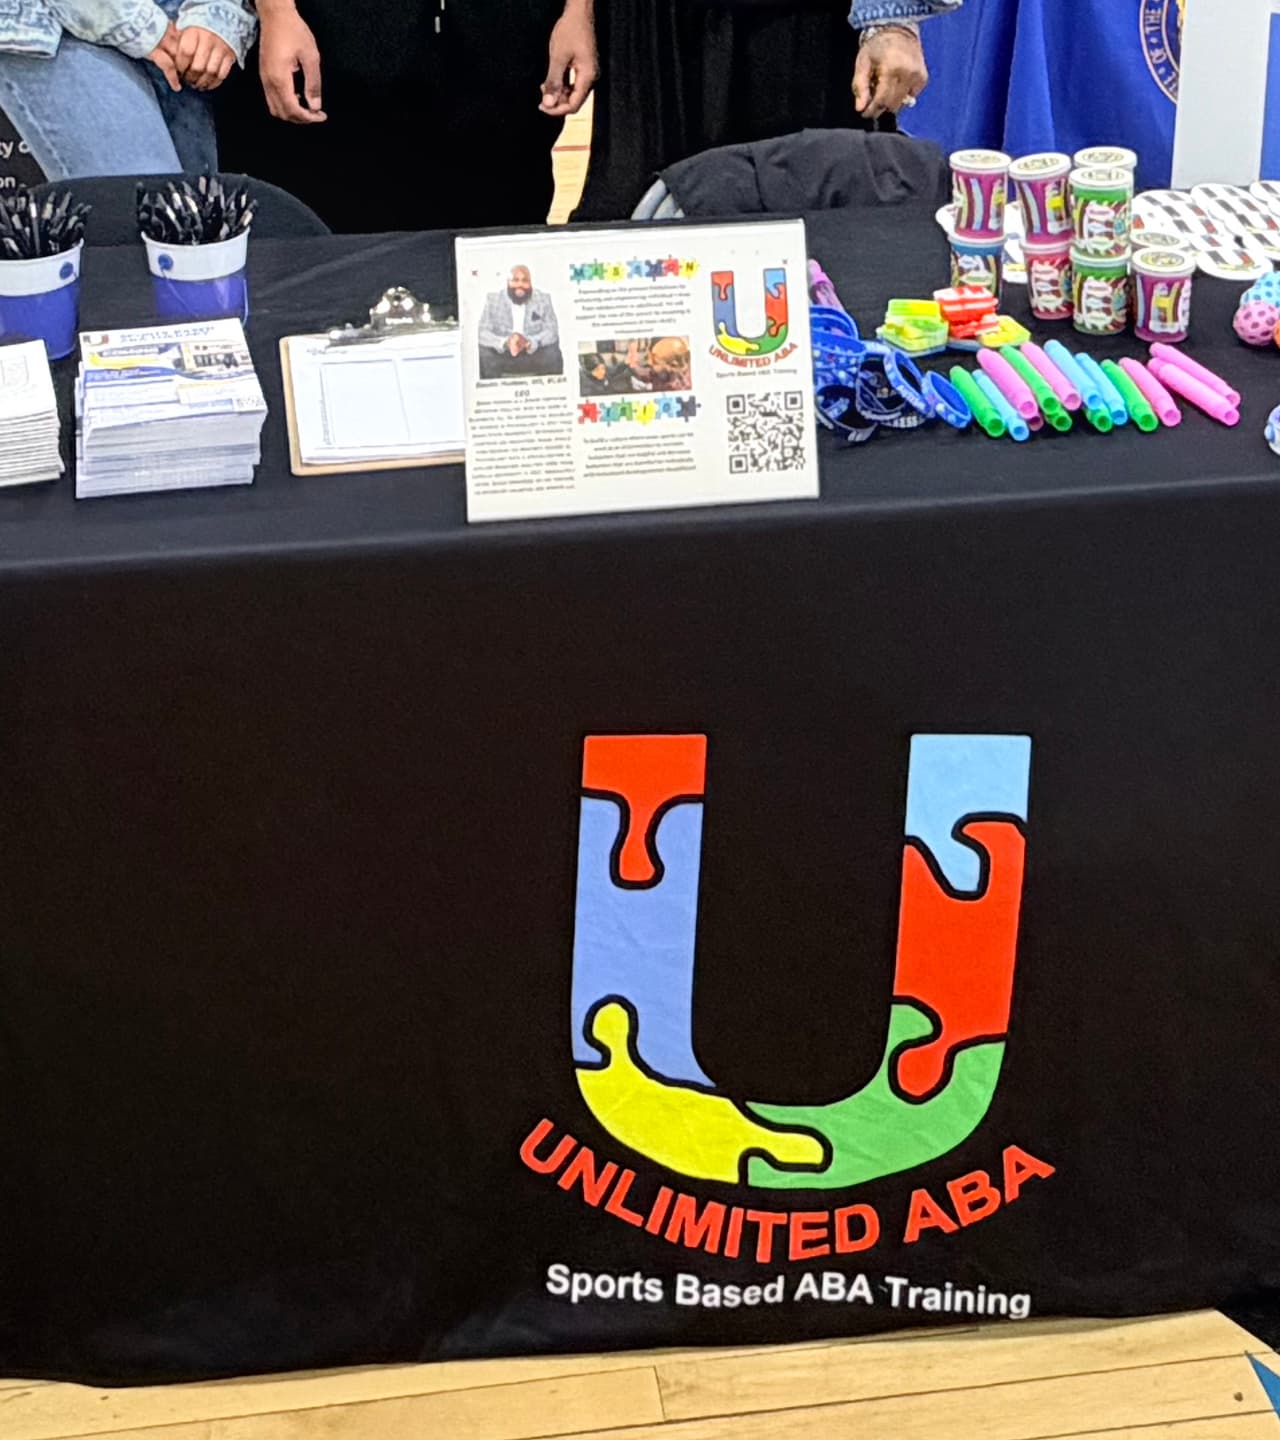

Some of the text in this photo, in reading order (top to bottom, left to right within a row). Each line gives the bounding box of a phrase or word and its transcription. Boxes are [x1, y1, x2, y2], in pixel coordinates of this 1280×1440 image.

[520, 1119, 1056, 1262] UNLIMITED ABA
[546, 1265, 1031, 1318] Sports Based ABA Training
